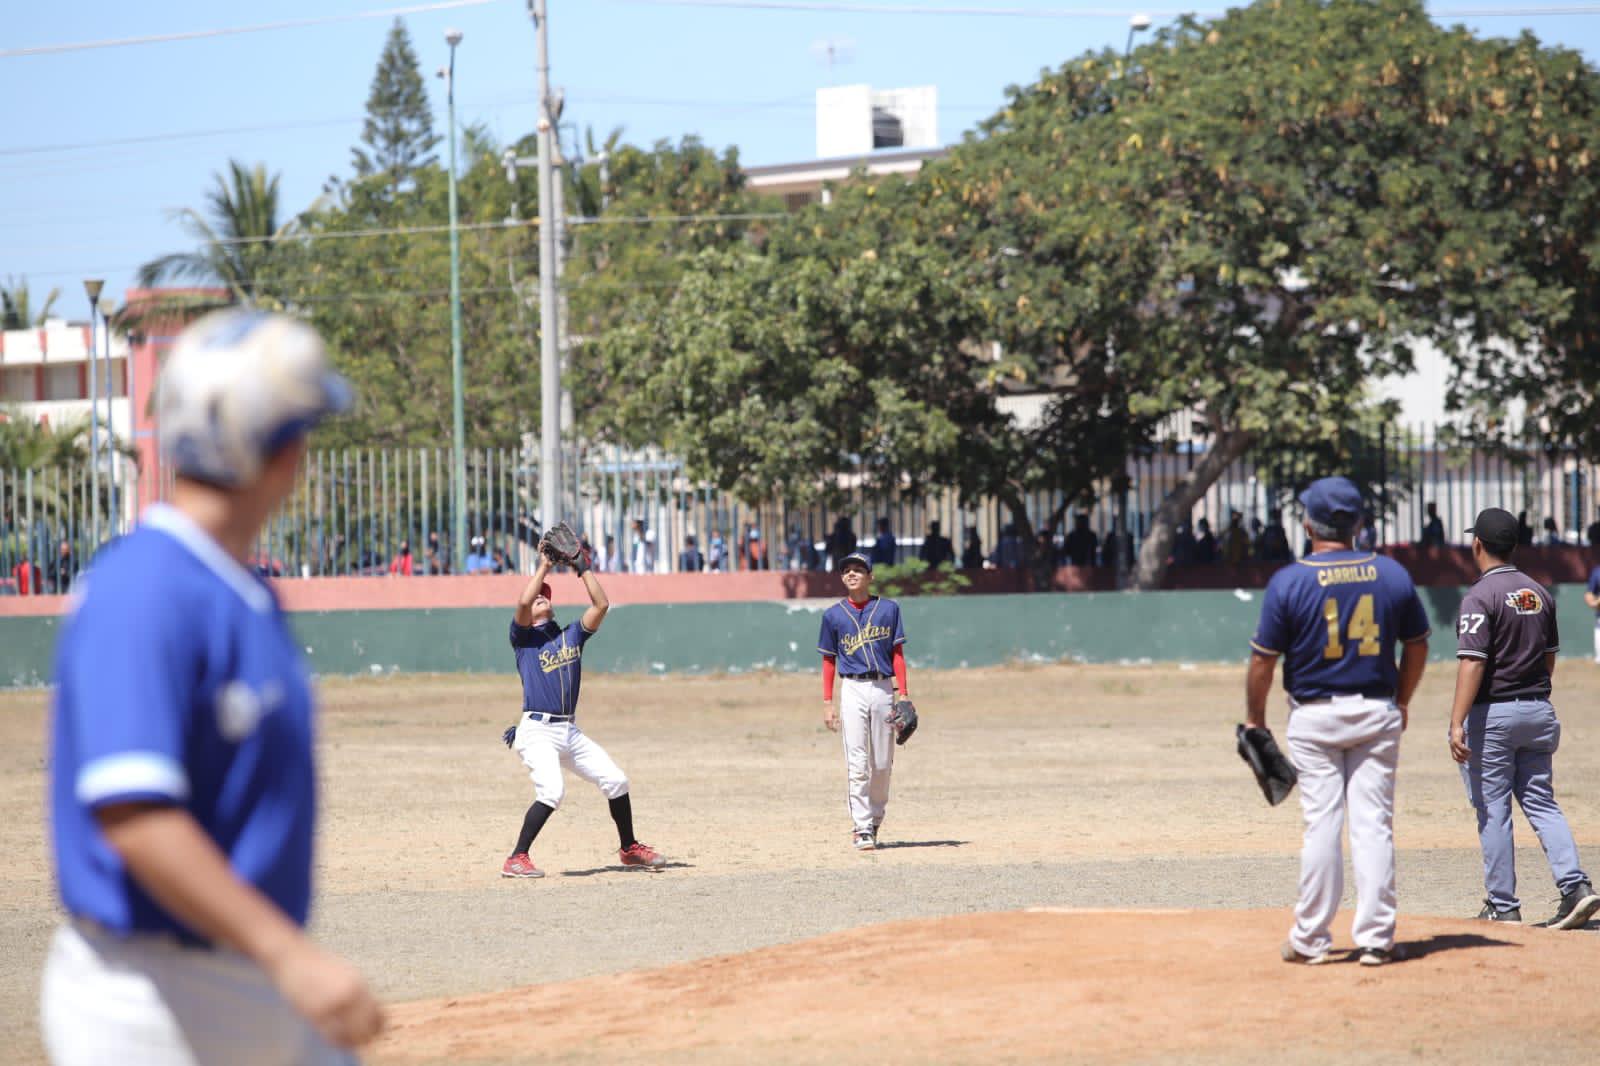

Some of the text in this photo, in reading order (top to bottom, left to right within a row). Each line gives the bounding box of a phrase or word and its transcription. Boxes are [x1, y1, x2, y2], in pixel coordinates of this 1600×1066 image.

[1318, 565, 1377, 586] CARRILLO
[1323, 593, 1381, 660] 14
[1459, 614, 1485, 634] 57
